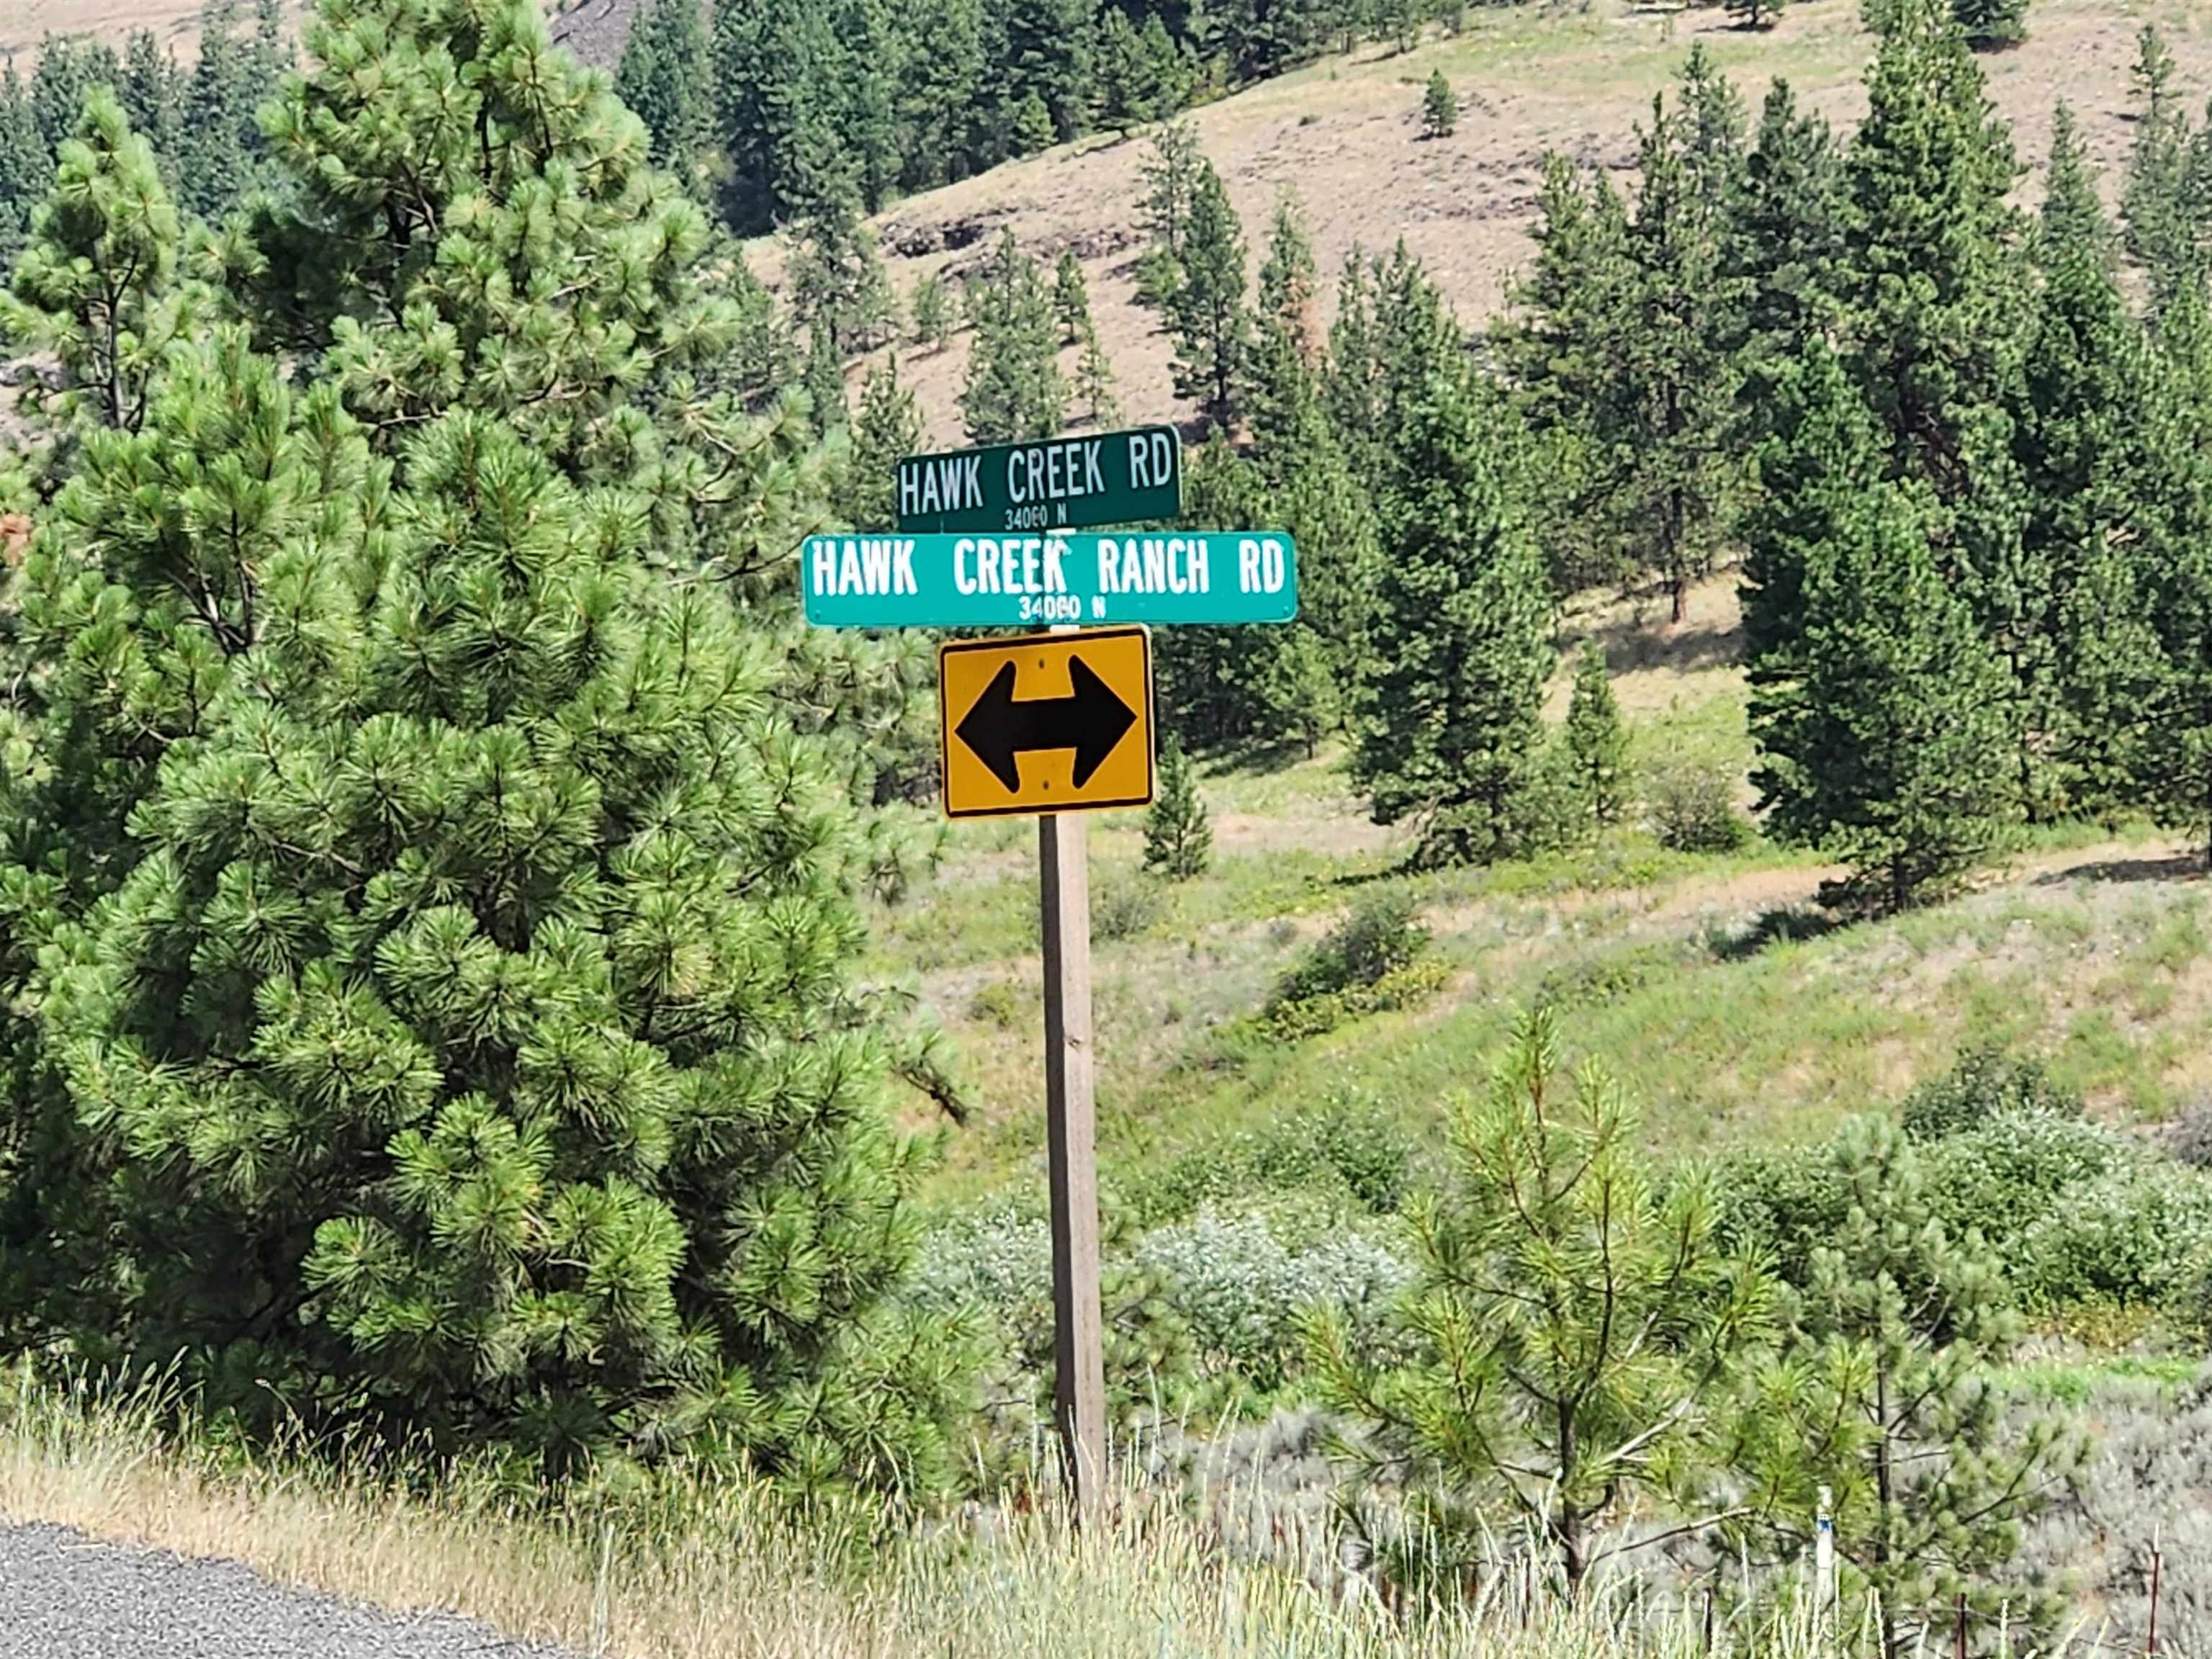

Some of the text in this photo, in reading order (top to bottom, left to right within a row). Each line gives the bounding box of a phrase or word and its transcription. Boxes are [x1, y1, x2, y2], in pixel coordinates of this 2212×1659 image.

[900, 432, 1172, 516] HAWK CREEK RD
[1057, 503, 1066, 523] N
[812, 538, 1285, 596] HAWK CREEK RANCH RD
[1091, 595, 1106, 619] N
